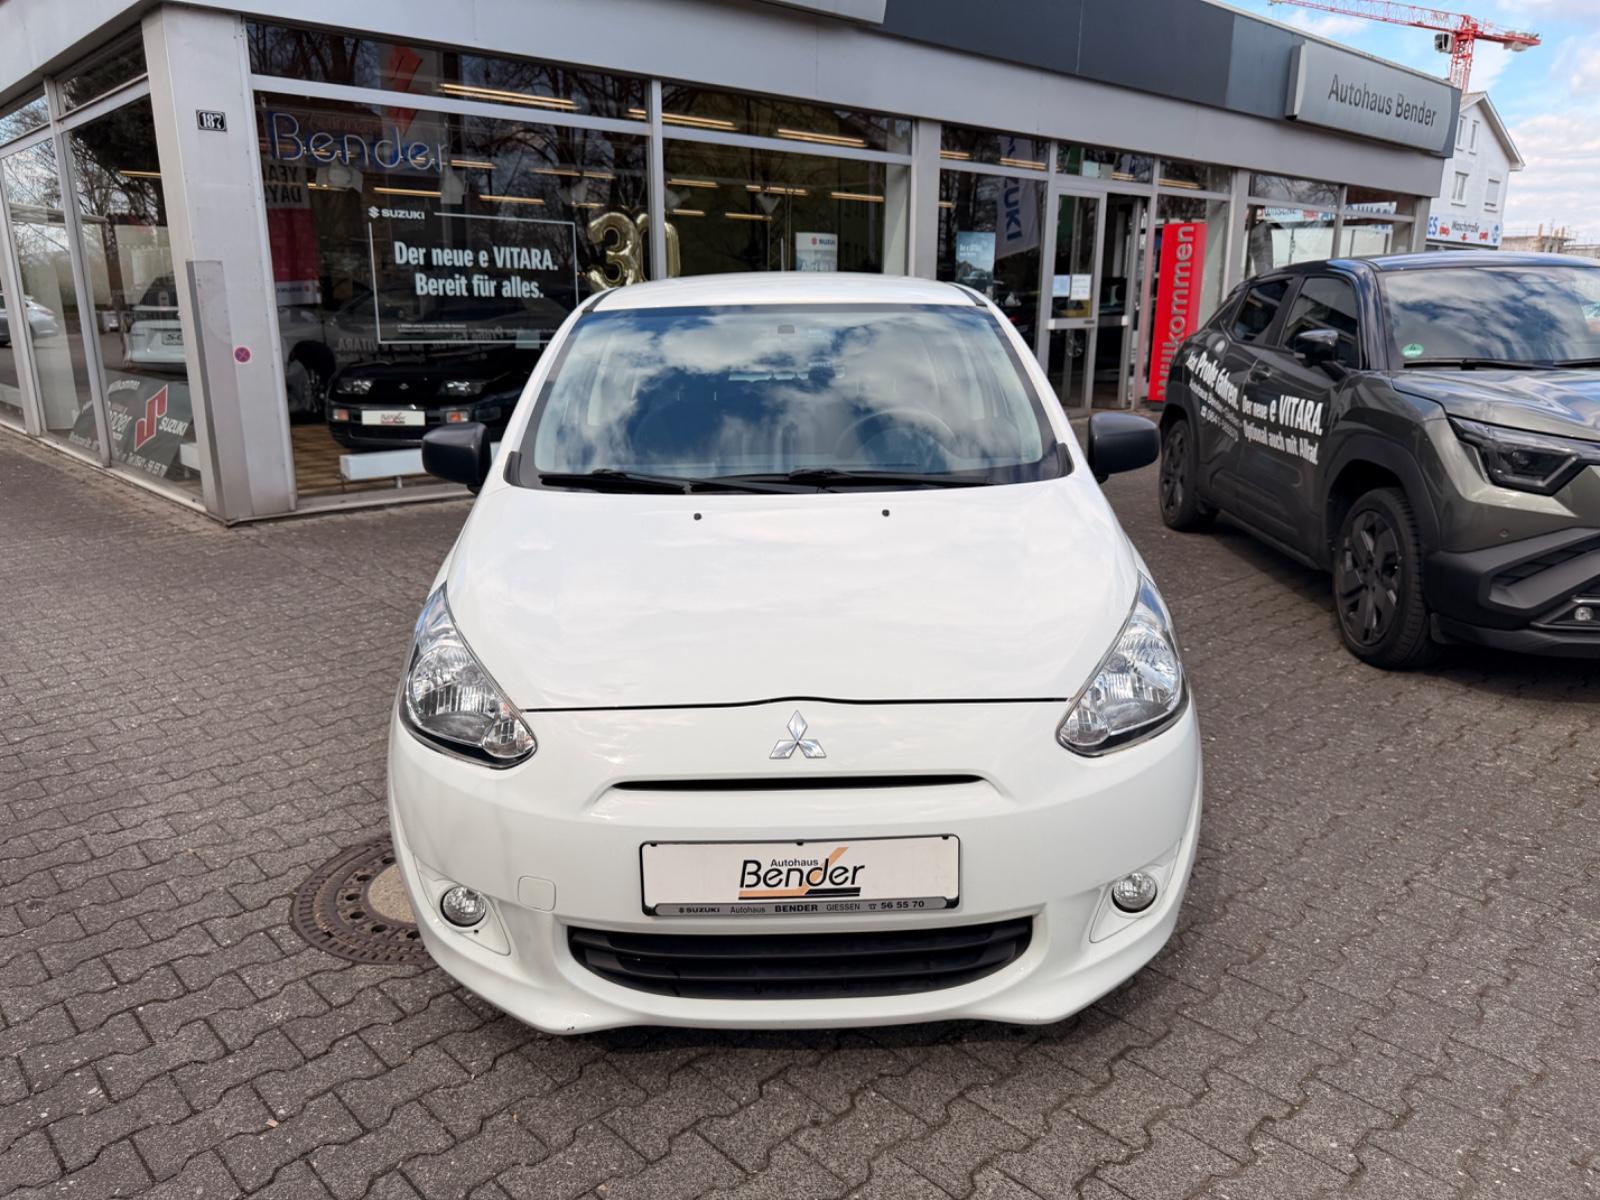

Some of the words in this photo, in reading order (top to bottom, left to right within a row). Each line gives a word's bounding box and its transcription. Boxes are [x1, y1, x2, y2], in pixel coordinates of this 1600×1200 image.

[1328, 74, 1393, 116] Autohaus
[1395, 93, 1437, 127] Bender
[201, 113, 223, 130] 187
[271, 112, 448, 173] Bender
[381, 208, 425, 220] SUZUKI
[394, 241, 426, 265] Der
[432, 246, 474, 267] neue
[479, 249, 489, 268] e
[493, 246, 558, 271] VITARA.
[415, 272, 468, 296] Bereit
[472, 274, 497, 298] für
[502, 276, 544, 299] alles.
[158, 416, 189, 437] SUZUKI
[1269, 399, 1277, 423] e
[1279, 394, 1323, 436] VITARA.
[739, 857, 866, 888] Bender
[771, 858, 819, 867] Autohaus
[730, 905, 766, 914] Autohaus
[775, 904, 818, 913] BENDER
[826, 903, 860, 911] GIESSEN
[881, 901, 894, 909] 56
[897, 901, 910, 909] 55
[912, 900, 925, 908] 70
